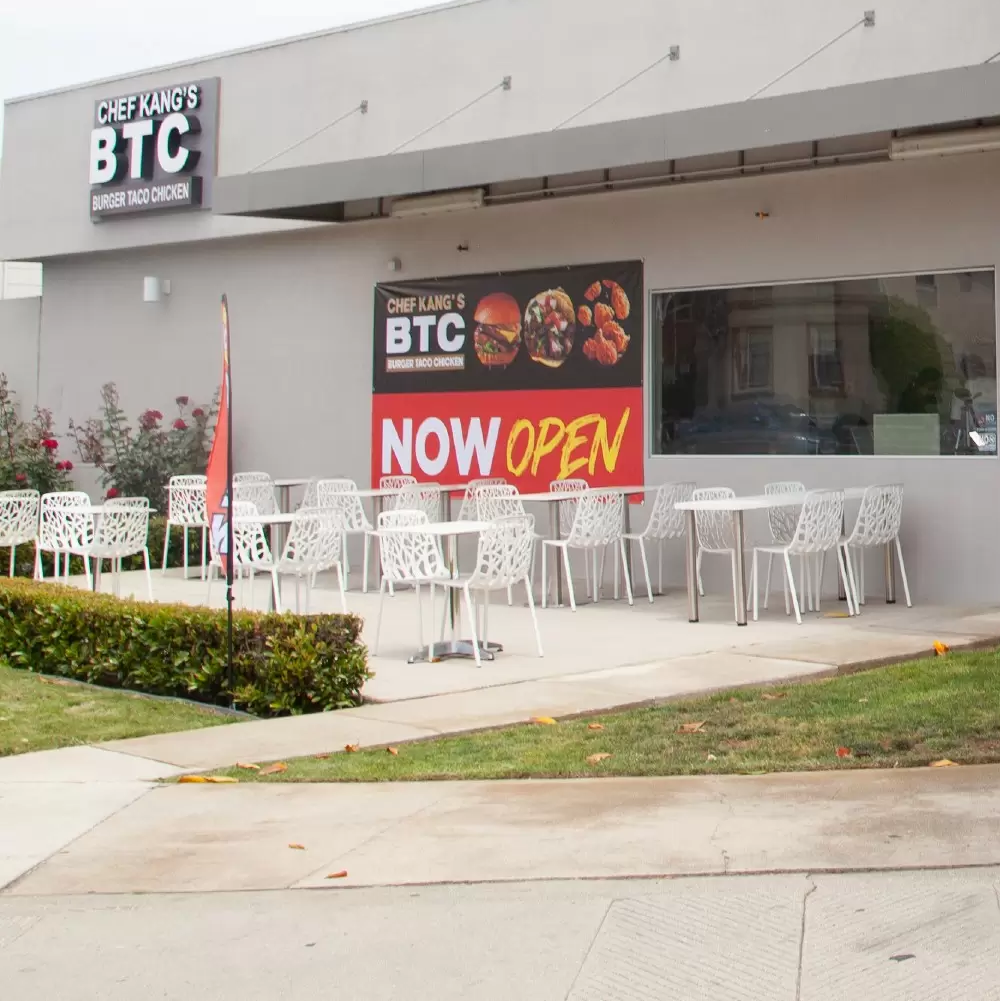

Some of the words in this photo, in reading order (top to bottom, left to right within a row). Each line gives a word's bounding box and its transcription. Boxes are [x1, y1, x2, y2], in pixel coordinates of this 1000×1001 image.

[98, 100, 136, 125] CHEF
[138, 84, 198, 118] KANG'S
[89, 112, 190, 184] BTC
[92, 191, 126, 211] BURGER
[127, 188, 150, 206] TACO
[151, 182, 189, 202] CHICKEN
[387, 298, 417, 314] CHEF
[418, 293, 465, 311] KANG'S
[386, 312, 466, 354] BTC
[387, 359, 414, 369] BURGER
[415, 358, 433, 368] TACO
[433, 356, 464, 367] CHICKEN
[382, 417, 502, 477] NOW
[506, 407, 631, 481] OPEN
